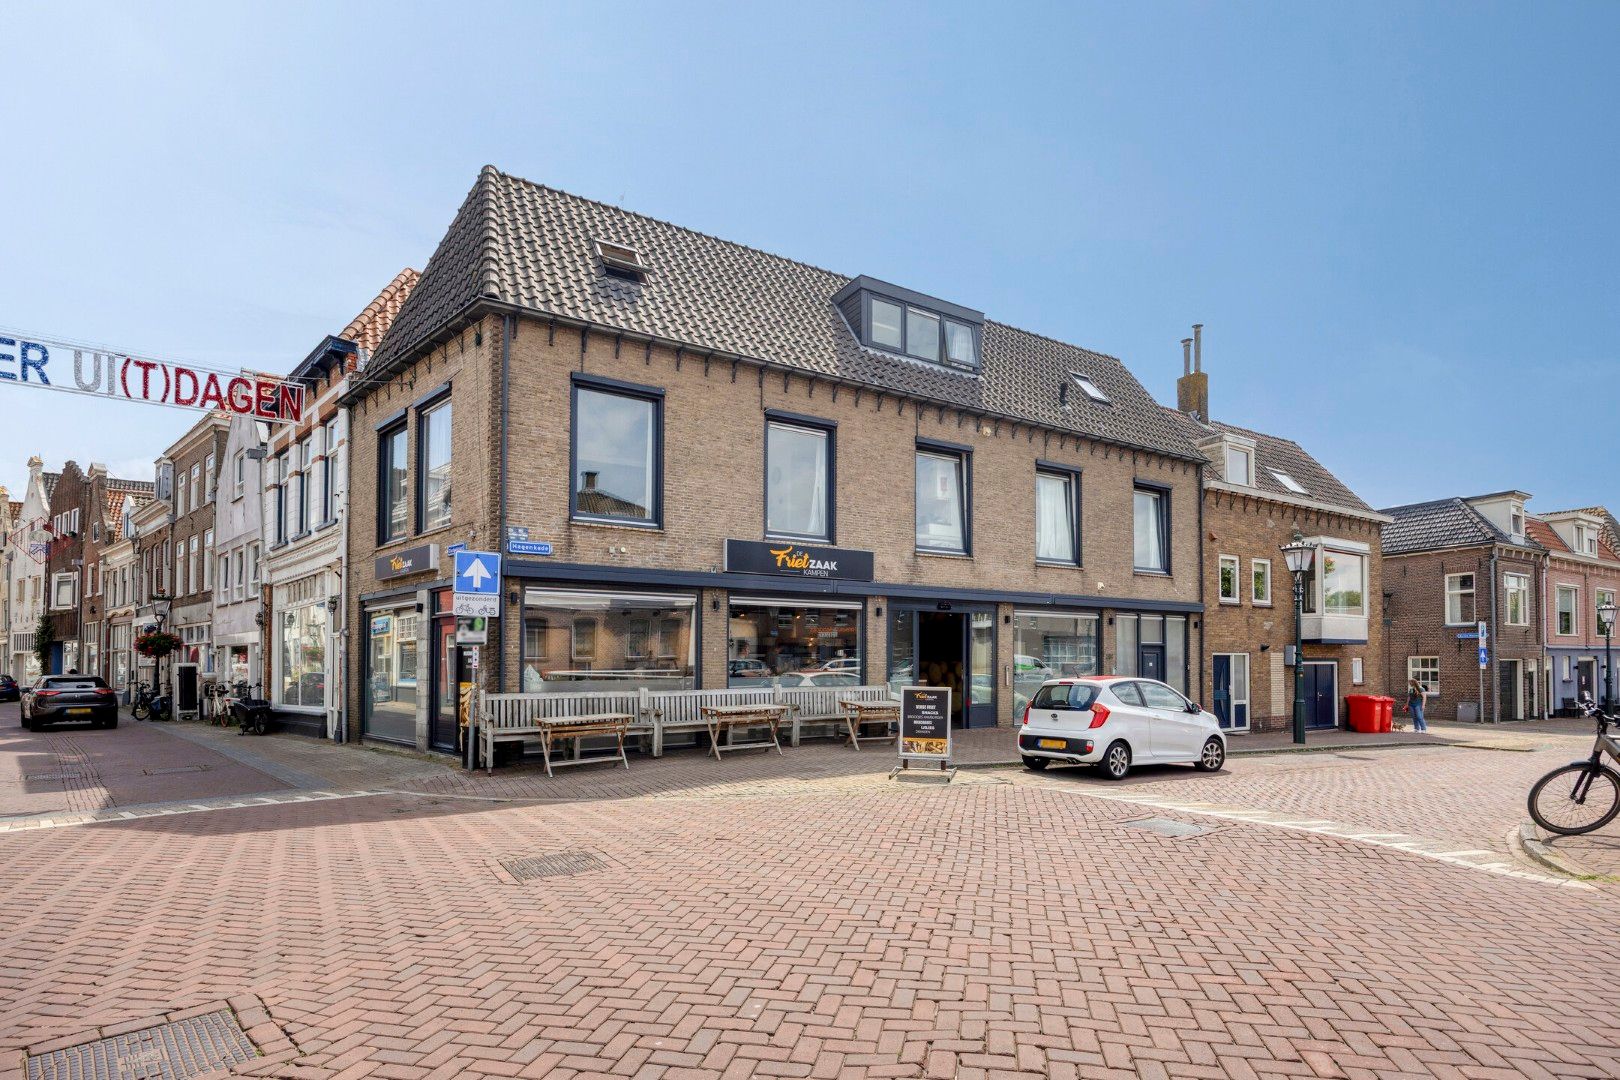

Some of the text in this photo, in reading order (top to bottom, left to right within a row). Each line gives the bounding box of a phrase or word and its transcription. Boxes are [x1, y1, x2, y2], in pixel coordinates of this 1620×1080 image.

[0, 337, 303, 422] ER UI(T)DAGEN
[803, 568, 829, 577] KAMPEN
